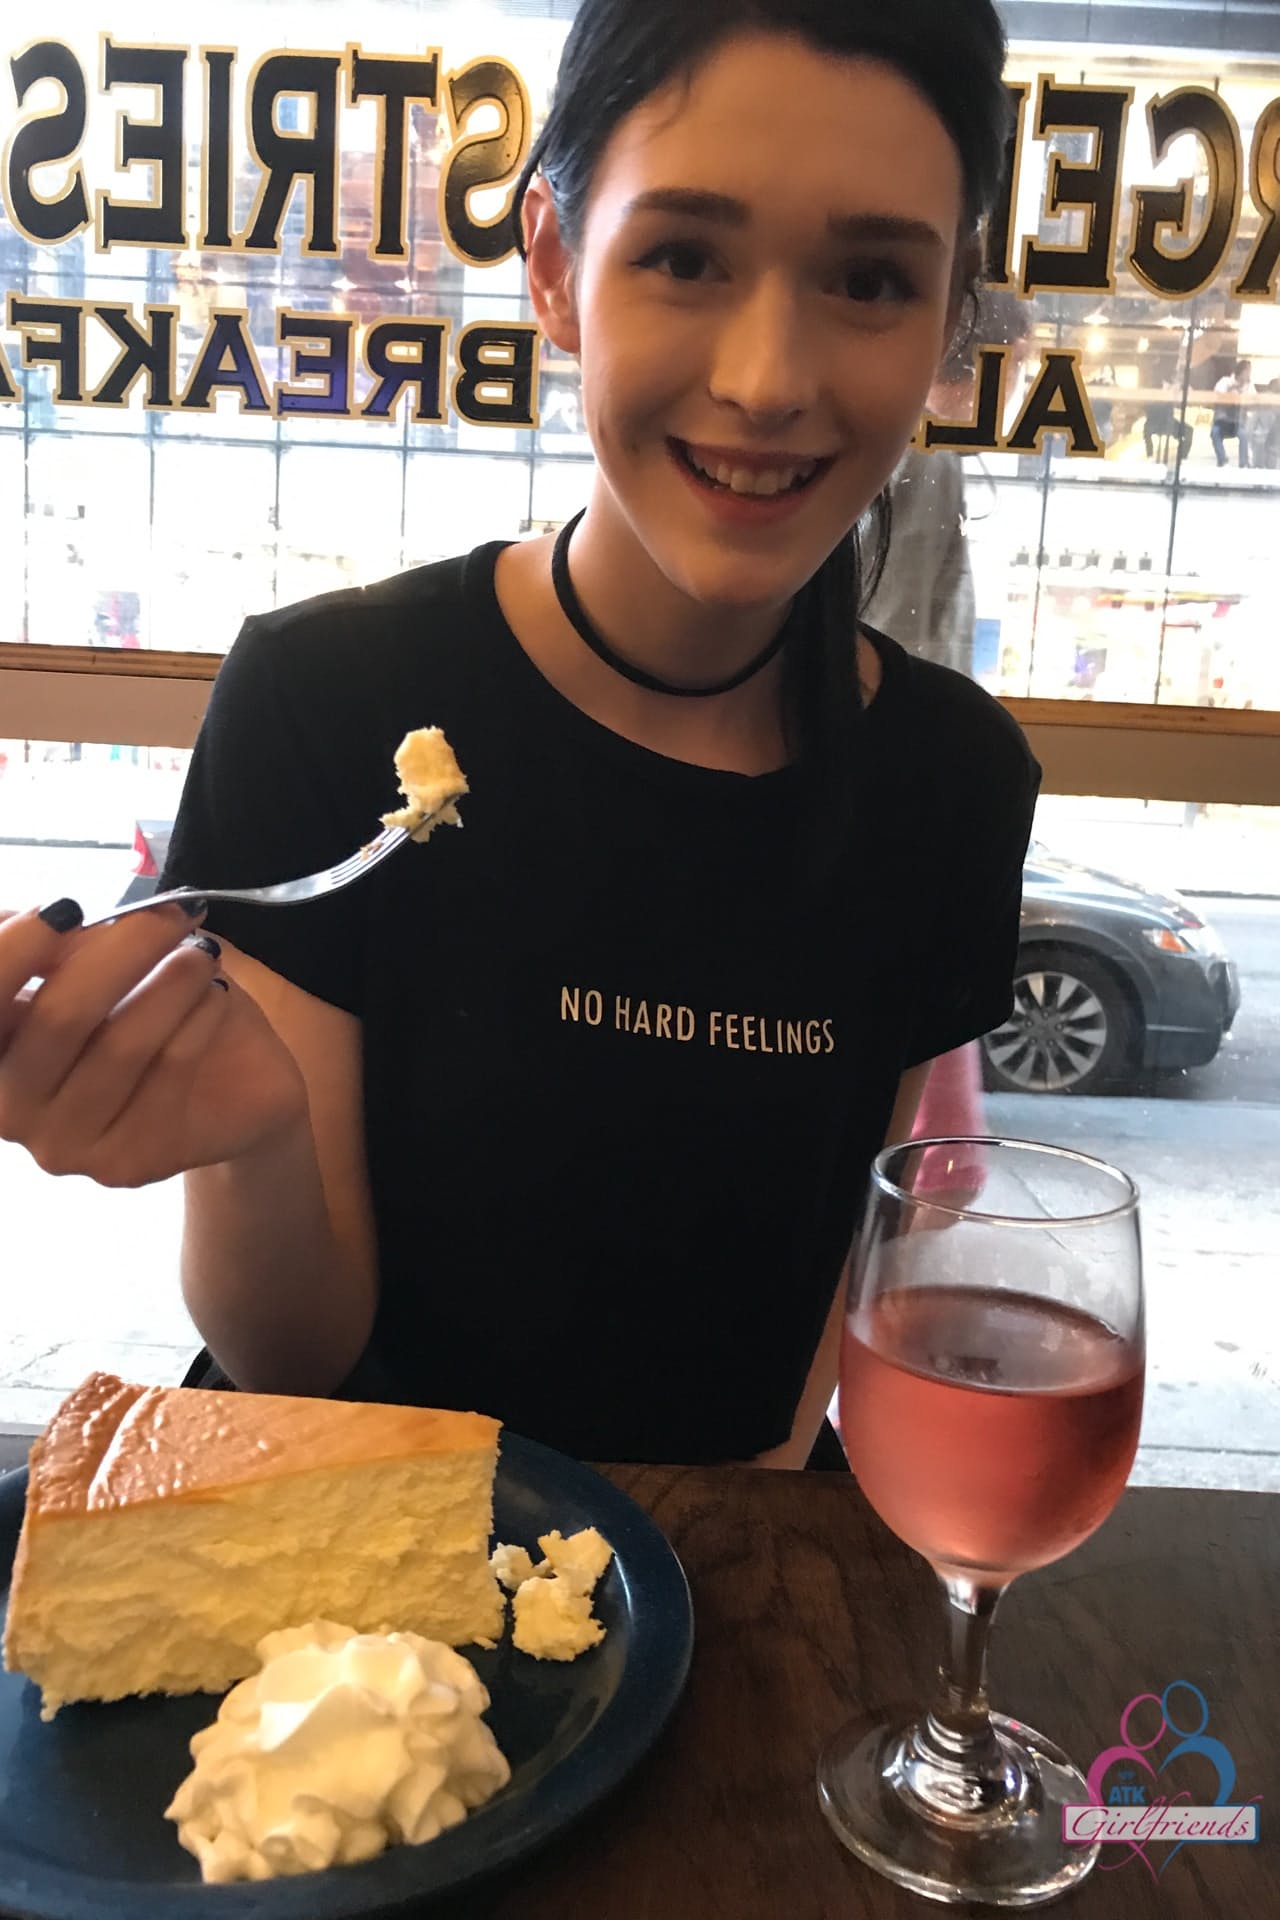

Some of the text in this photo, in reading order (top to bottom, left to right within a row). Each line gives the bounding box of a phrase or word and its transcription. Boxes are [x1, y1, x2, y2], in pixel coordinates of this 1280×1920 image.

[560, 986, 835, 1054] NO HARD FEELINGS
